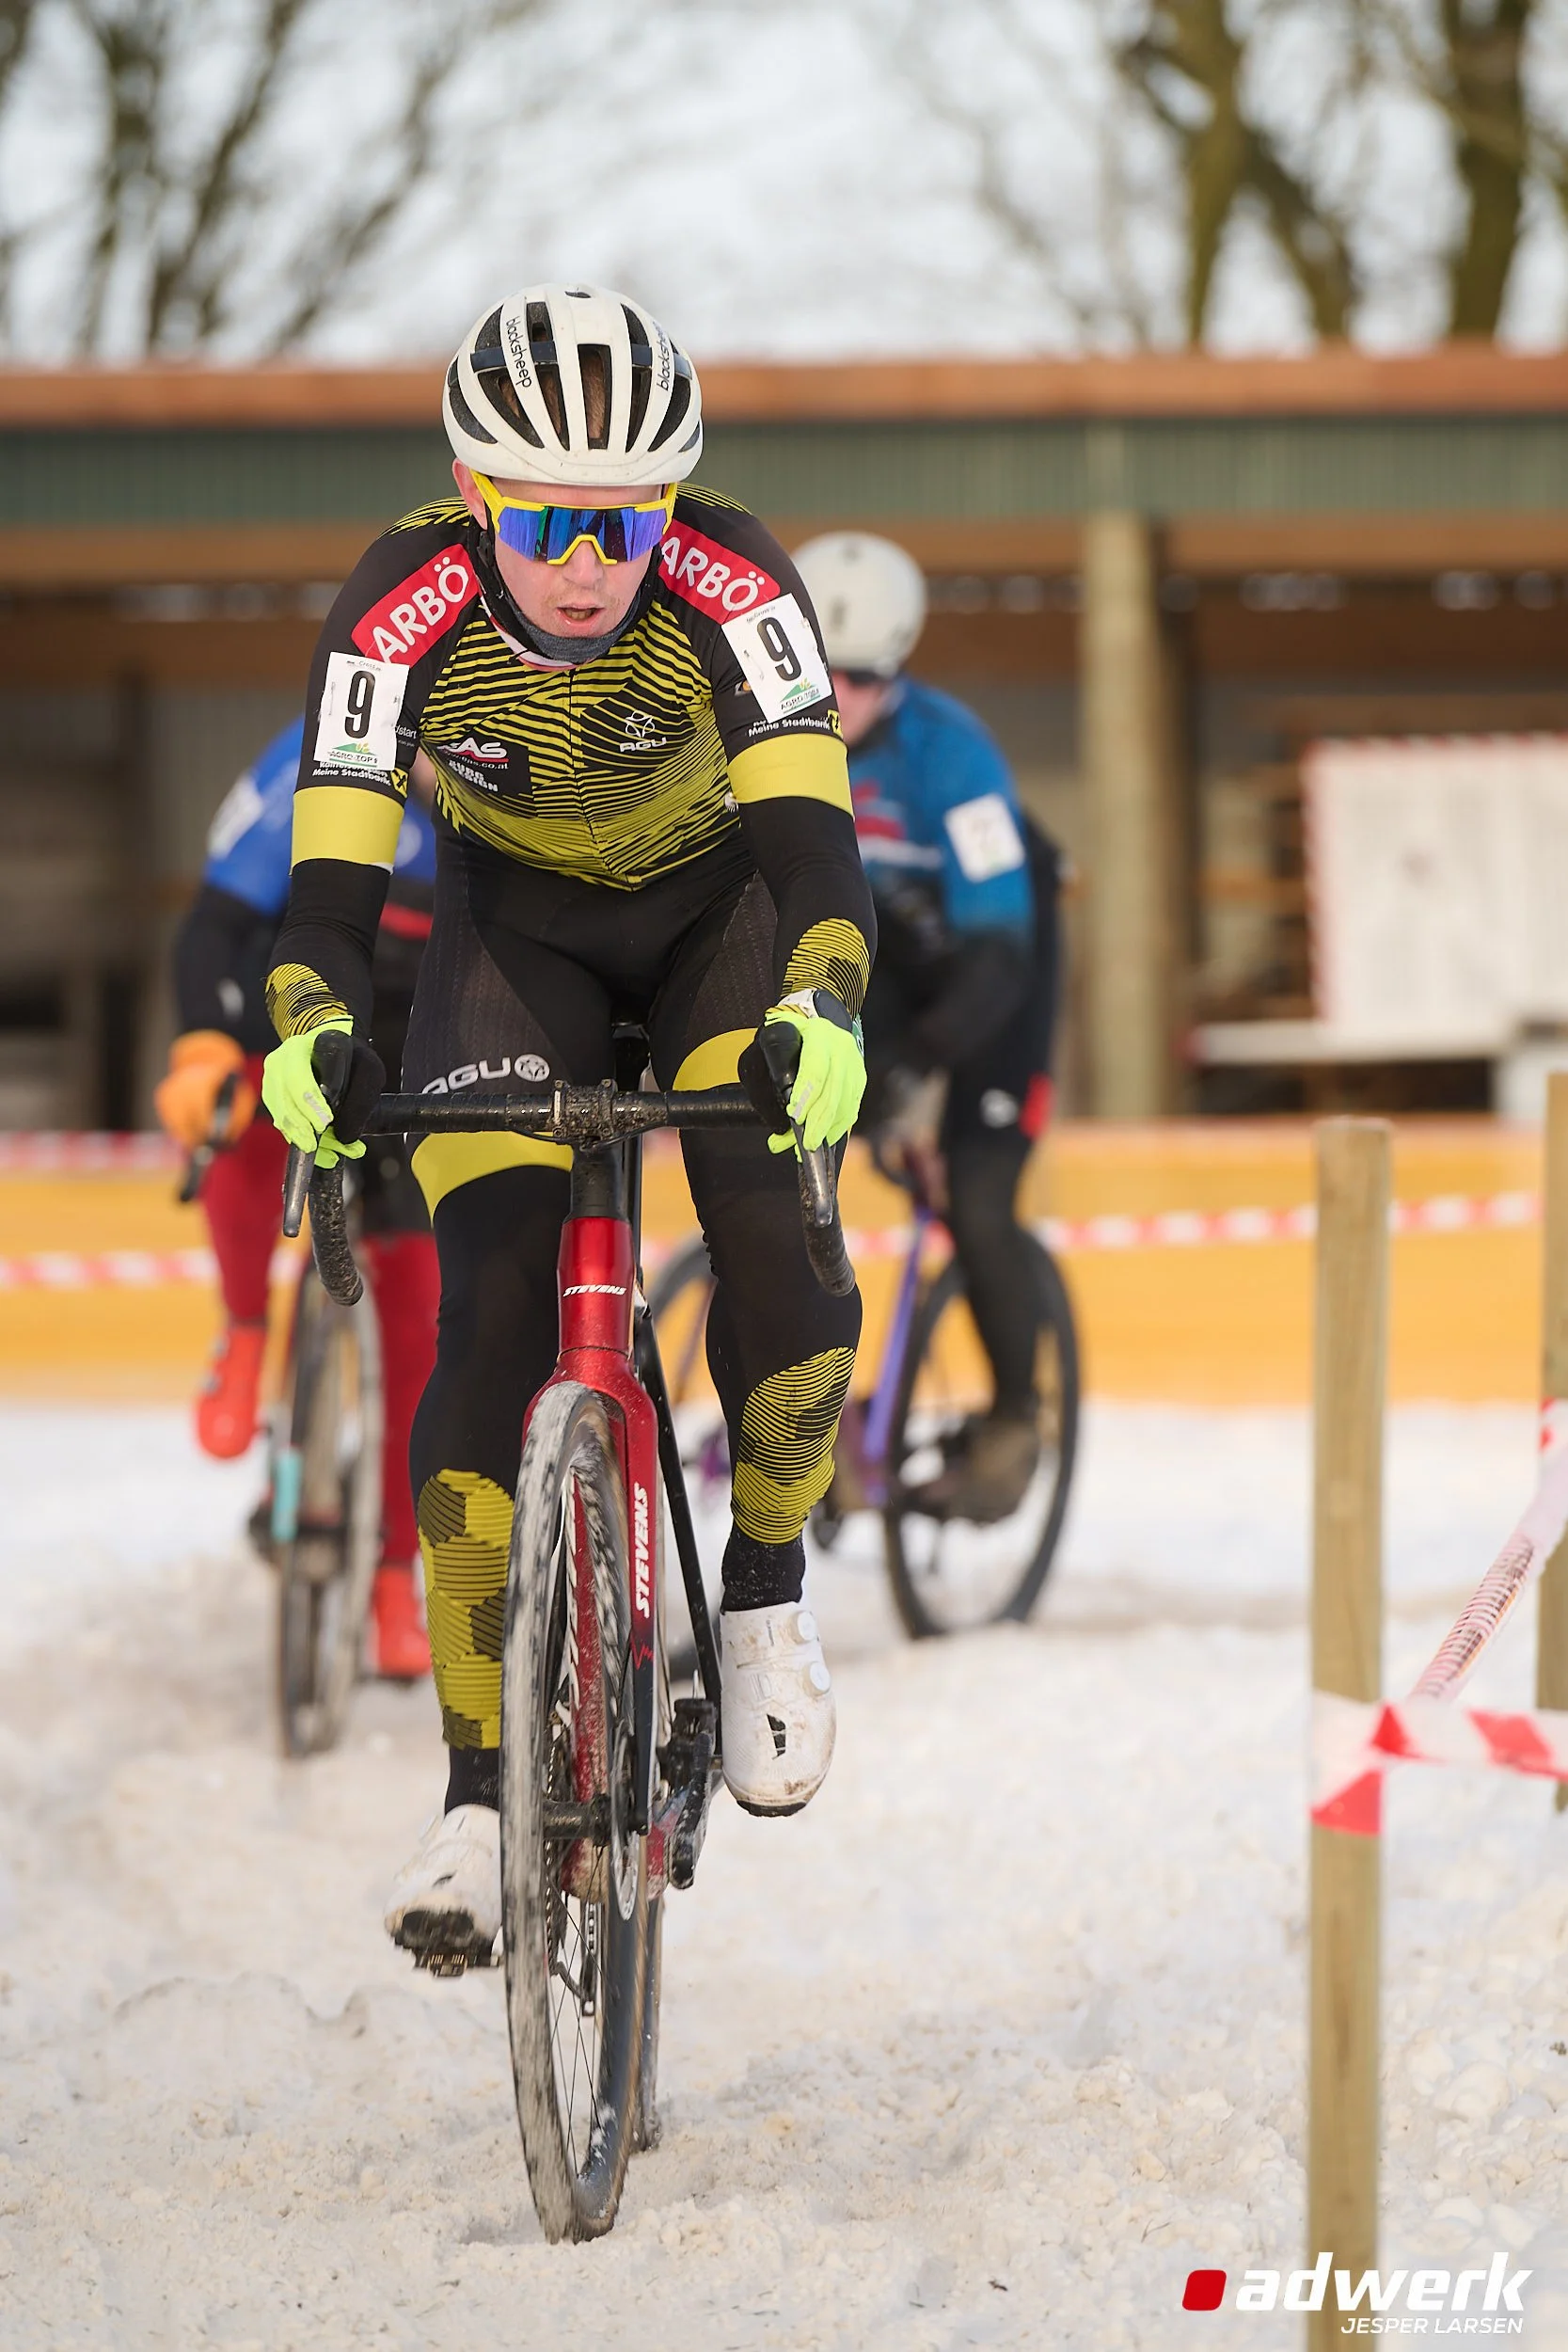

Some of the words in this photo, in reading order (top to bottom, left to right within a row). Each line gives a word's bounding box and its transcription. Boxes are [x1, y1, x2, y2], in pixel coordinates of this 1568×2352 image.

[506, 316, 532, 389] blacksheep
[660, 536, 766, 612] ARBÖ
[372, 556, 469, 663] ARBÖ
[756, 616, 802, 682] 9
[344, 670, 376, 739] 9
[620, 737, 667, 752] AGU
[422, 1057, 512, 1094] AGU
[562, 1284, 627, 1297] STEVENS
[634, 1482, 650, 1618] STEVENS
